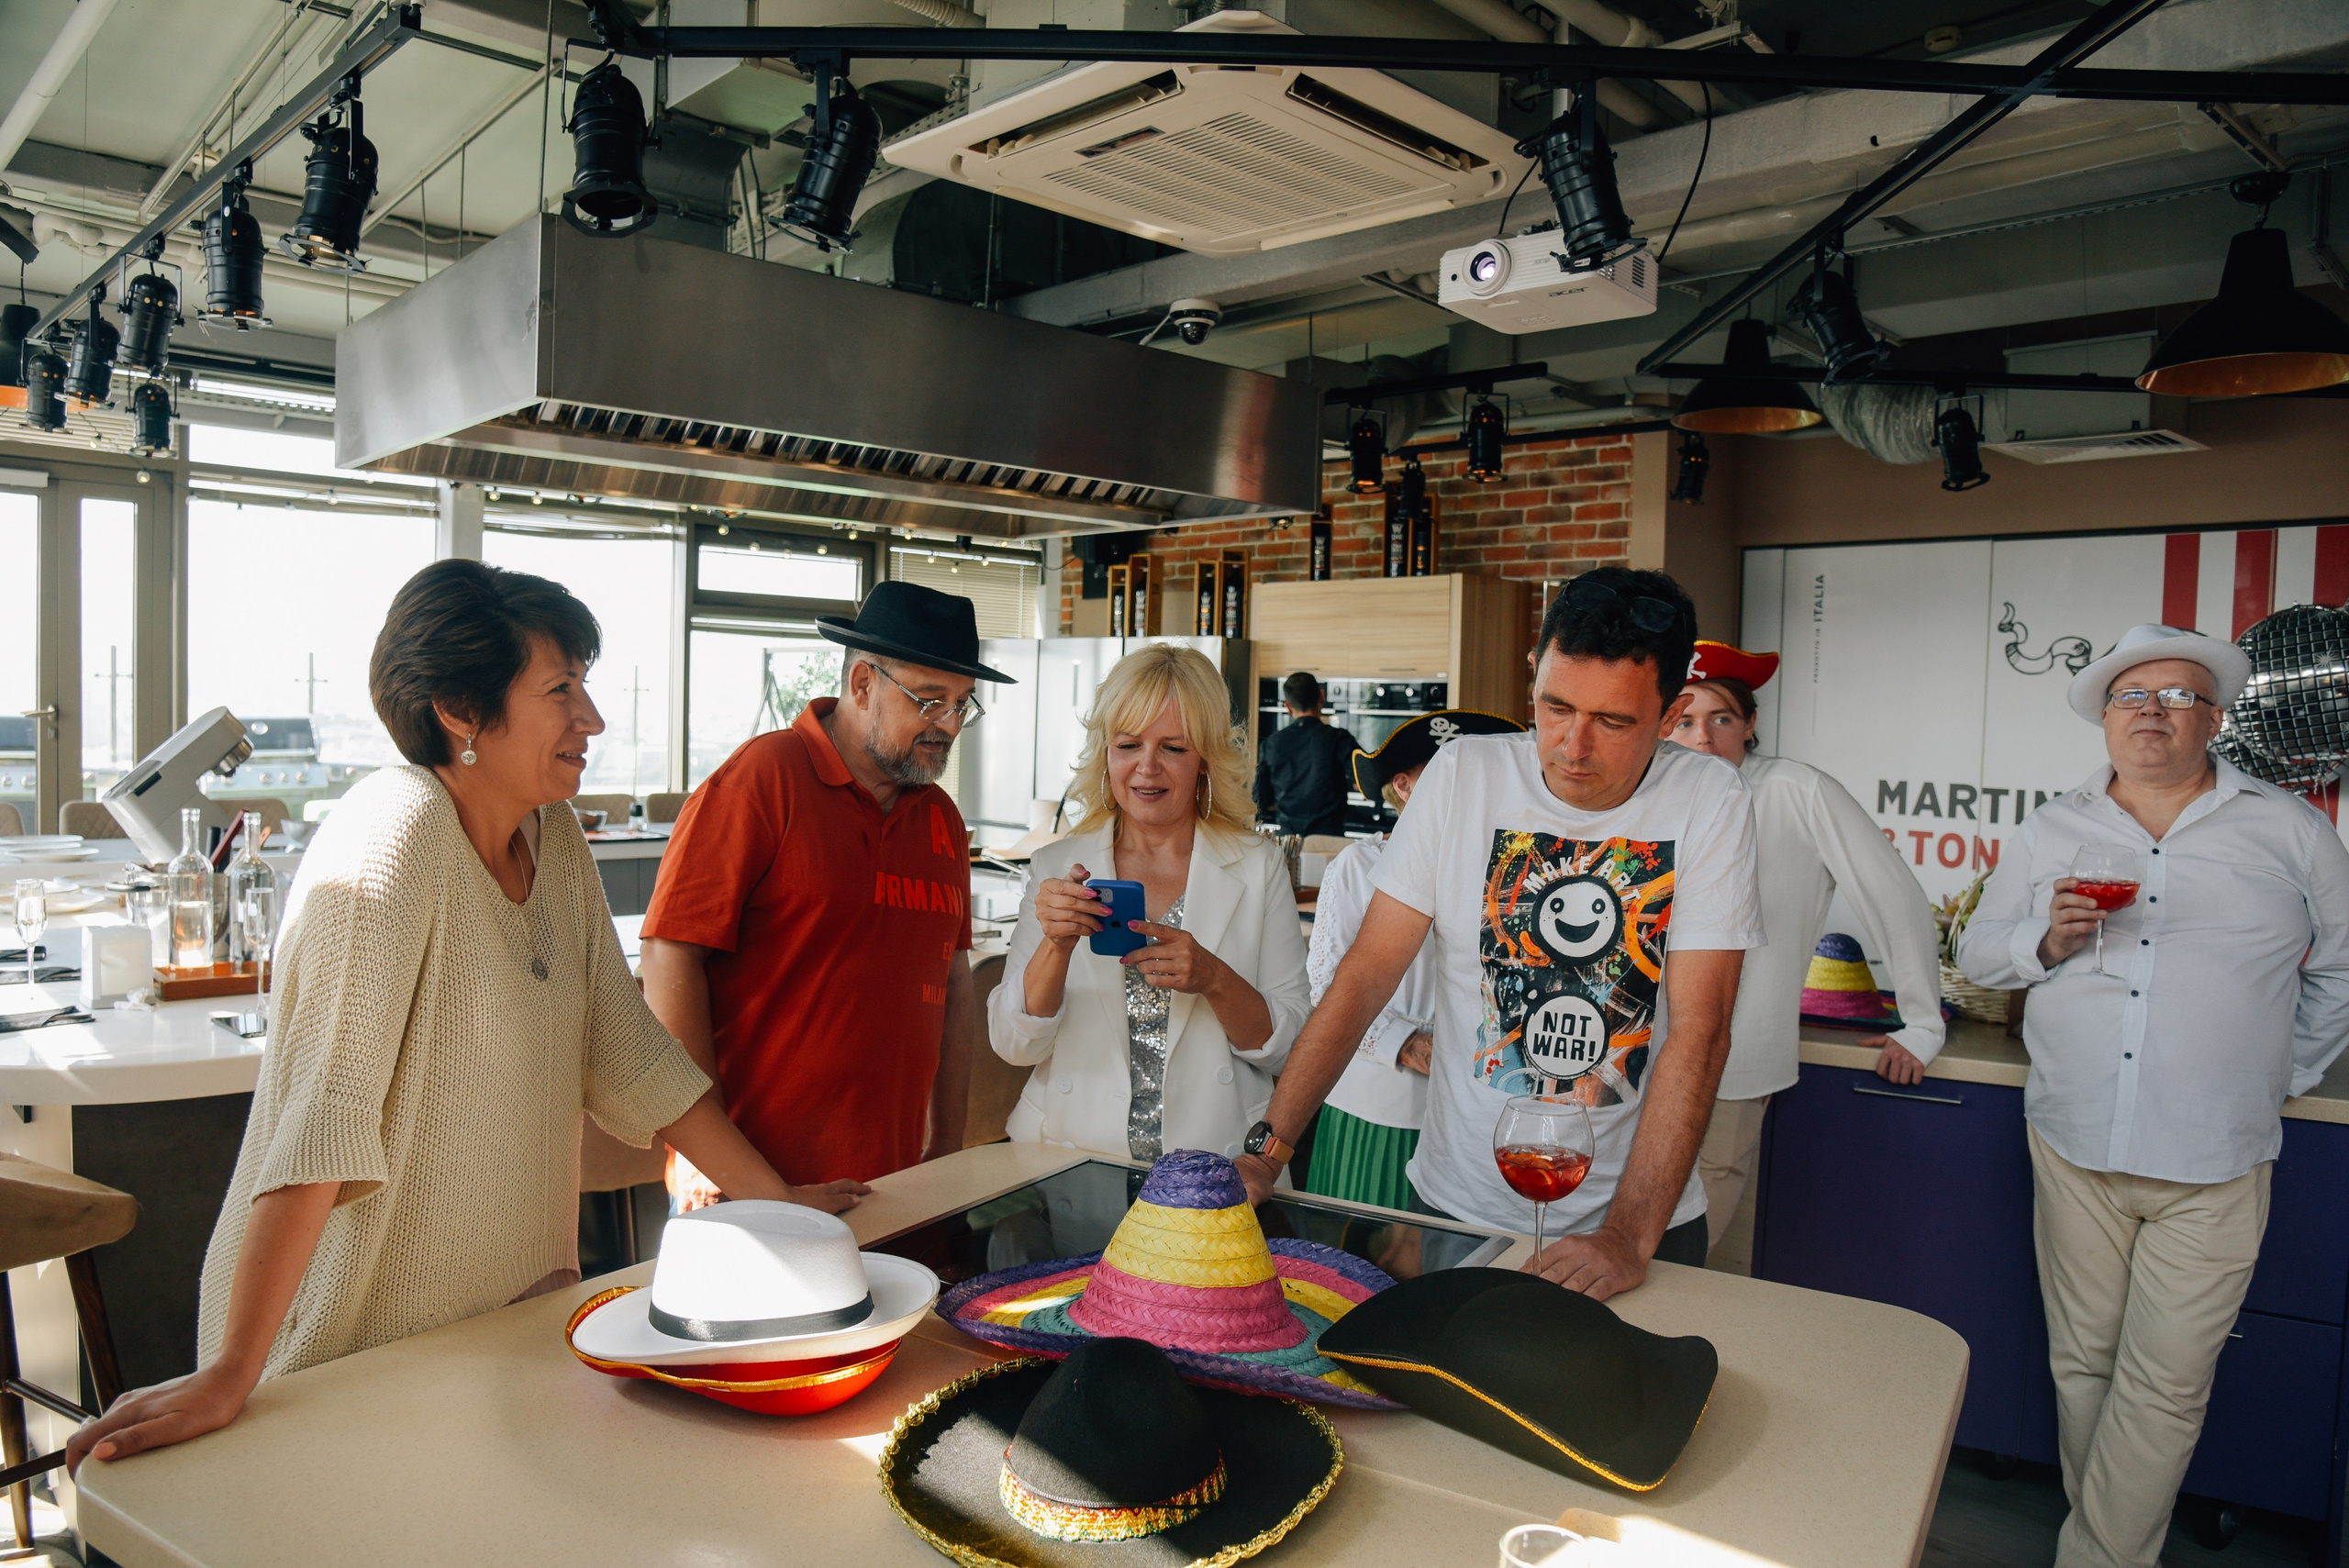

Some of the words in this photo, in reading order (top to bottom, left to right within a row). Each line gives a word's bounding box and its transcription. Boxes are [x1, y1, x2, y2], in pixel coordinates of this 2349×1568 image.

[1548, 286, 1588, 297] acer
[1813, 573, 1824, 622] ITALIA
[930, 803, 955, 859] A
[1522, 855, 1592, 895] MAKE
[1598, 858, 1642, 902] ART
[1542, 1010, 1592, 1037] NOT
[1532, 1032, 1597, 1062] WAR!
